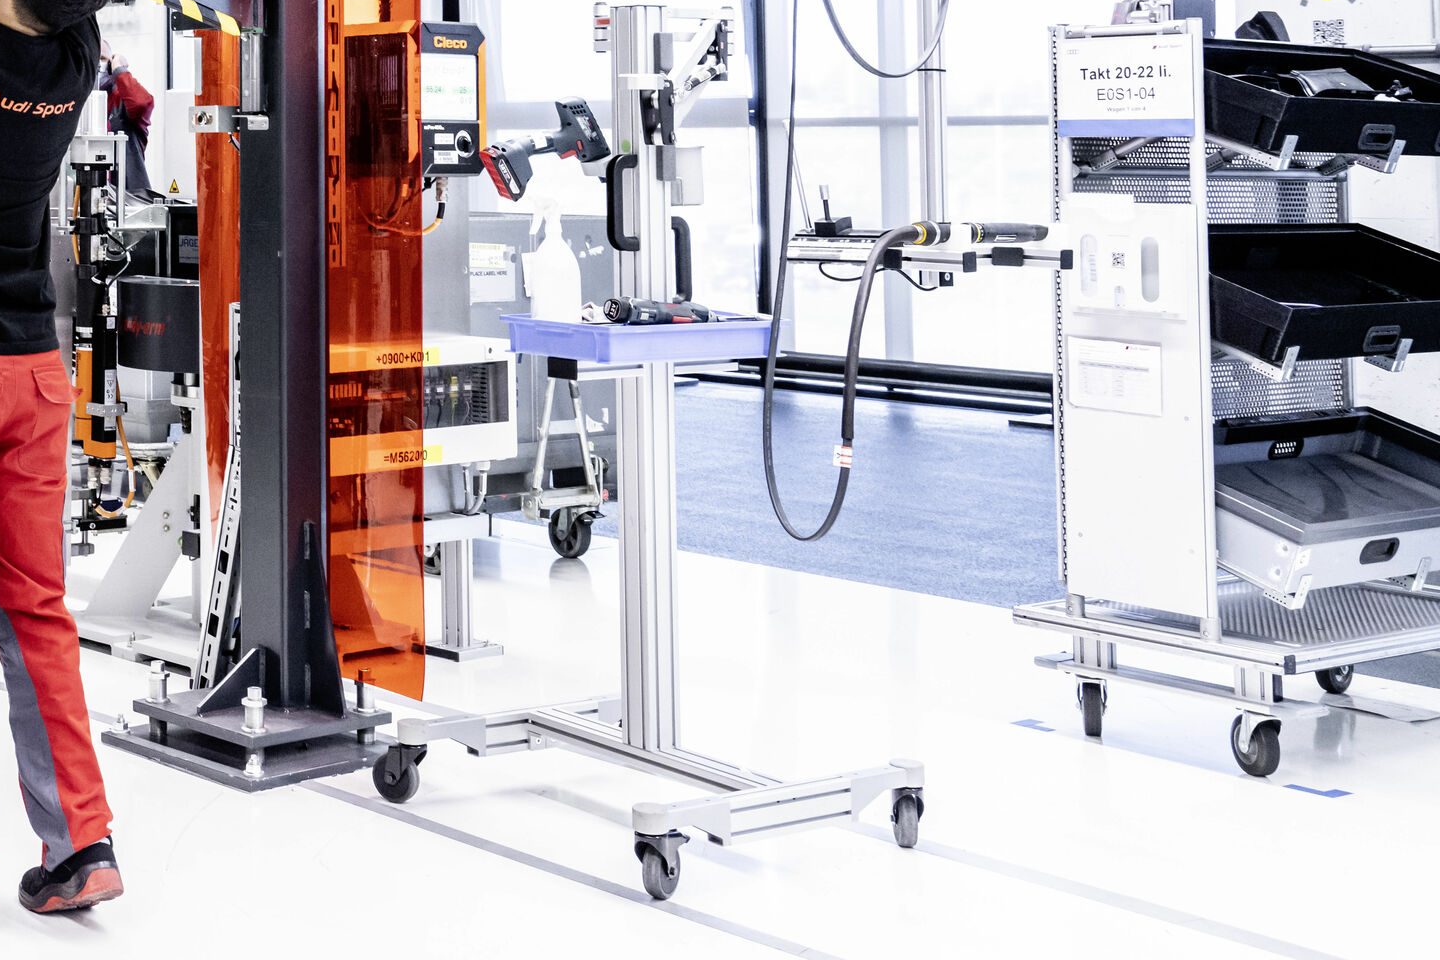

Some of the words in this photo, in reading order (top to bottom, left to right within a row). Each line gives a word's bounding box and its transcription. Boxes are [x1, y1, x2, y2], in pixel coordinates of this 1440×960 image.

[433, 35, 468, 49] Cleco
[1080, 67, 1111, 80] Takt
[1115, 65, 1154, 79] 20-22
[1159, 64, 1172, 78] li.
[32, 100, 76, 118] Sport
